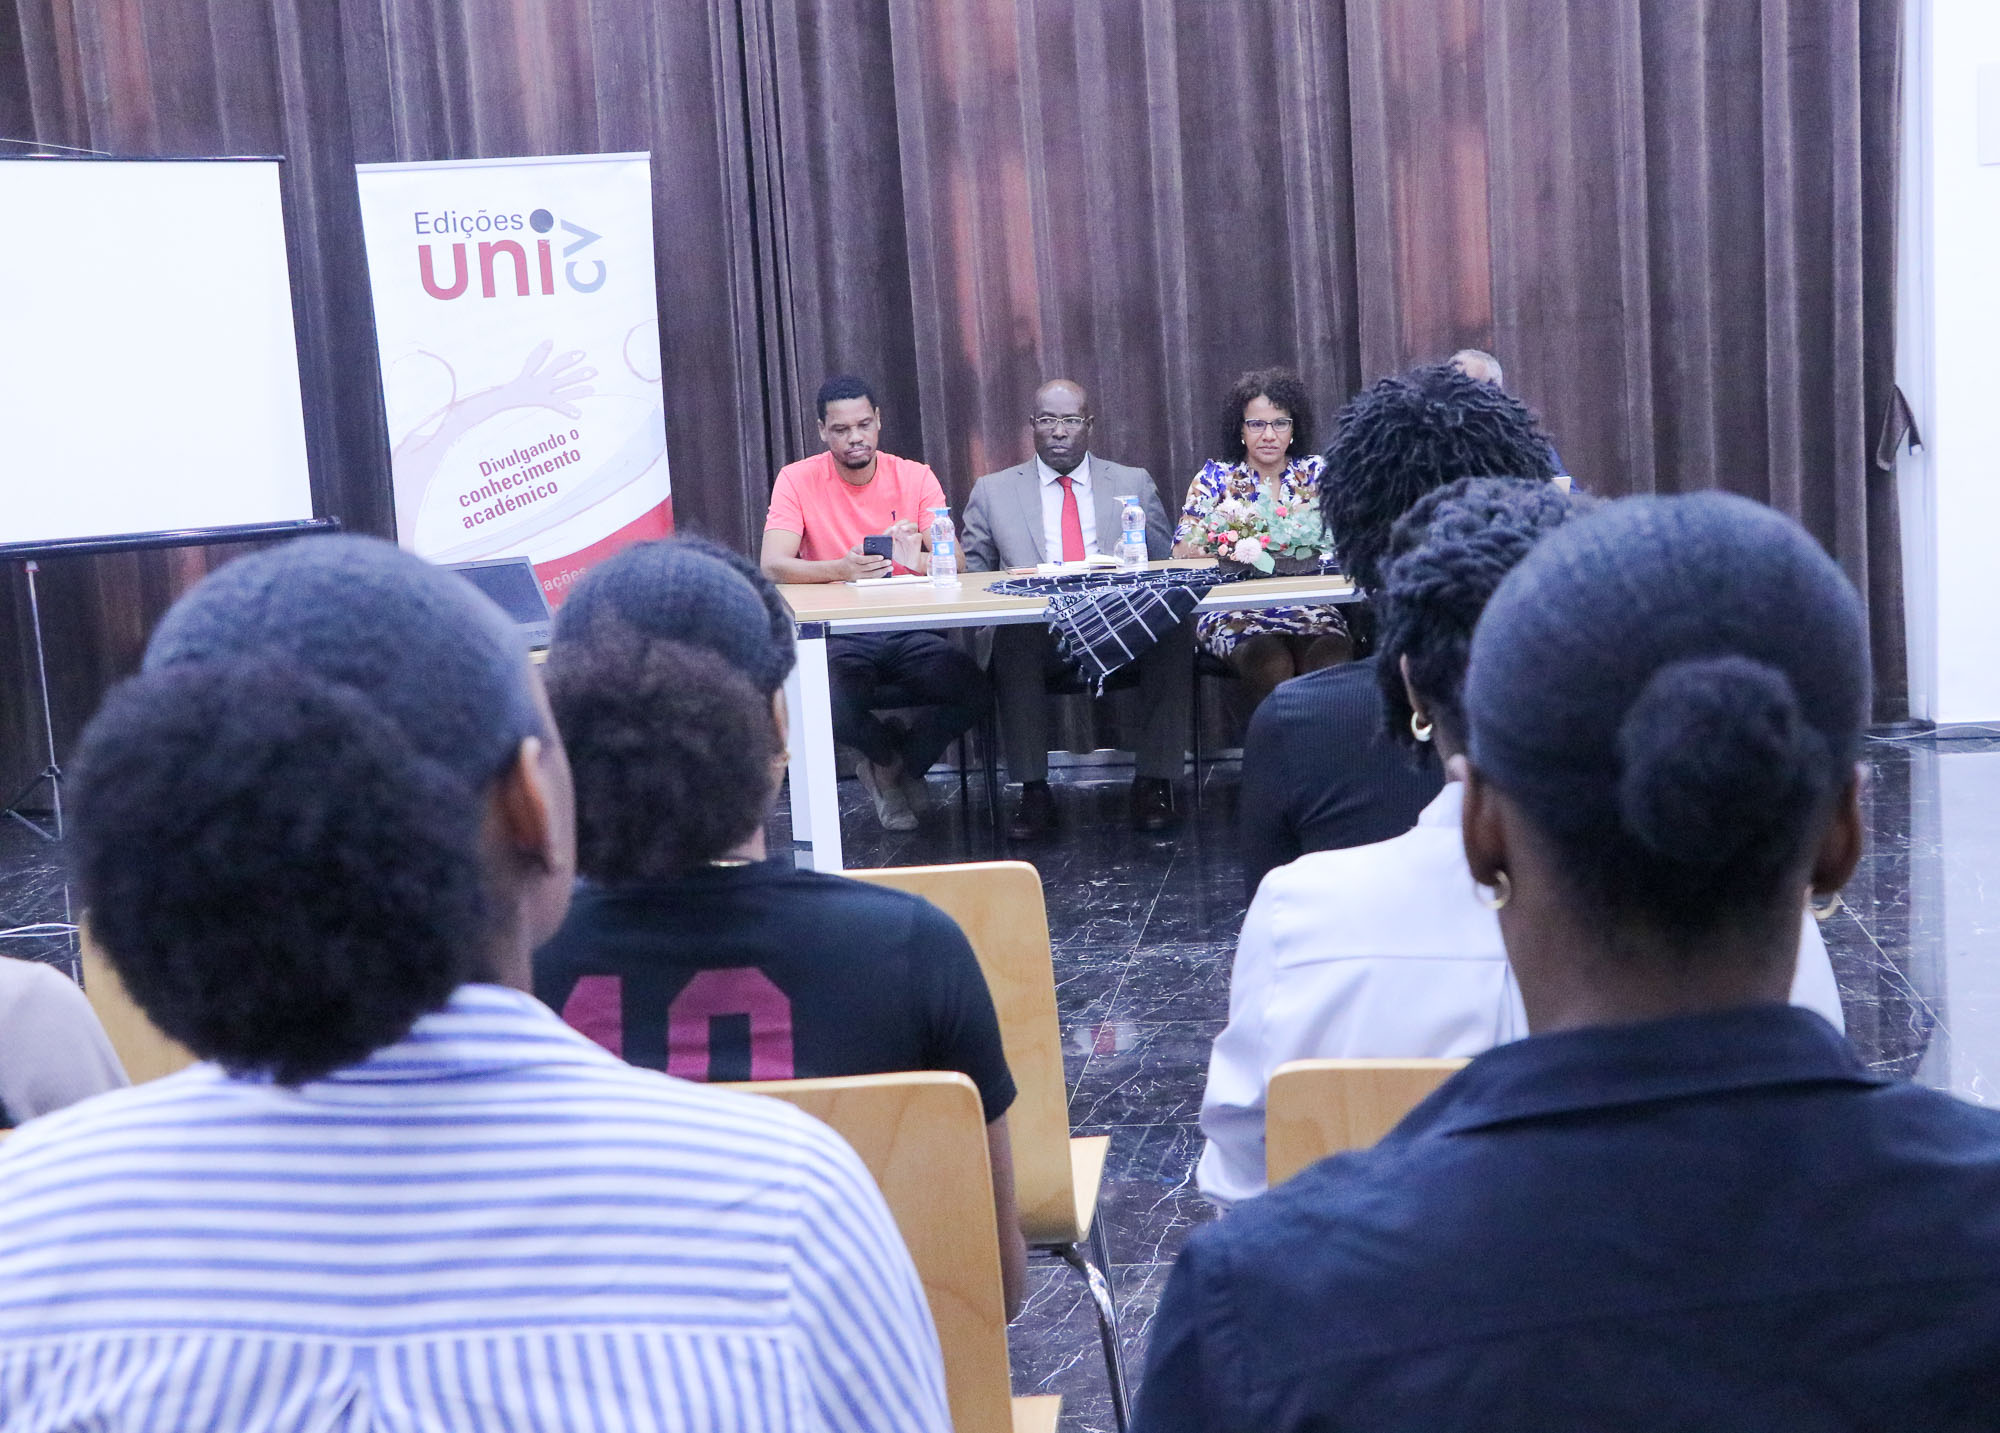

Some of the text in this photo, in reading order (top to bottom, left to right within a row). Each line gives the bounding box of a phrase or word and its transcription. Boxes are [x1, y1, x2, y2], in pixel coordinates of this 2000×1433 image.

[414, 209, 524, 238] Edições
[418, 209, 555, 300] uni
[478, 429, 580, 477] Divulgando o
[459, 449, 581, 507] conhecimento
[462, 482, 558, 529] académico
